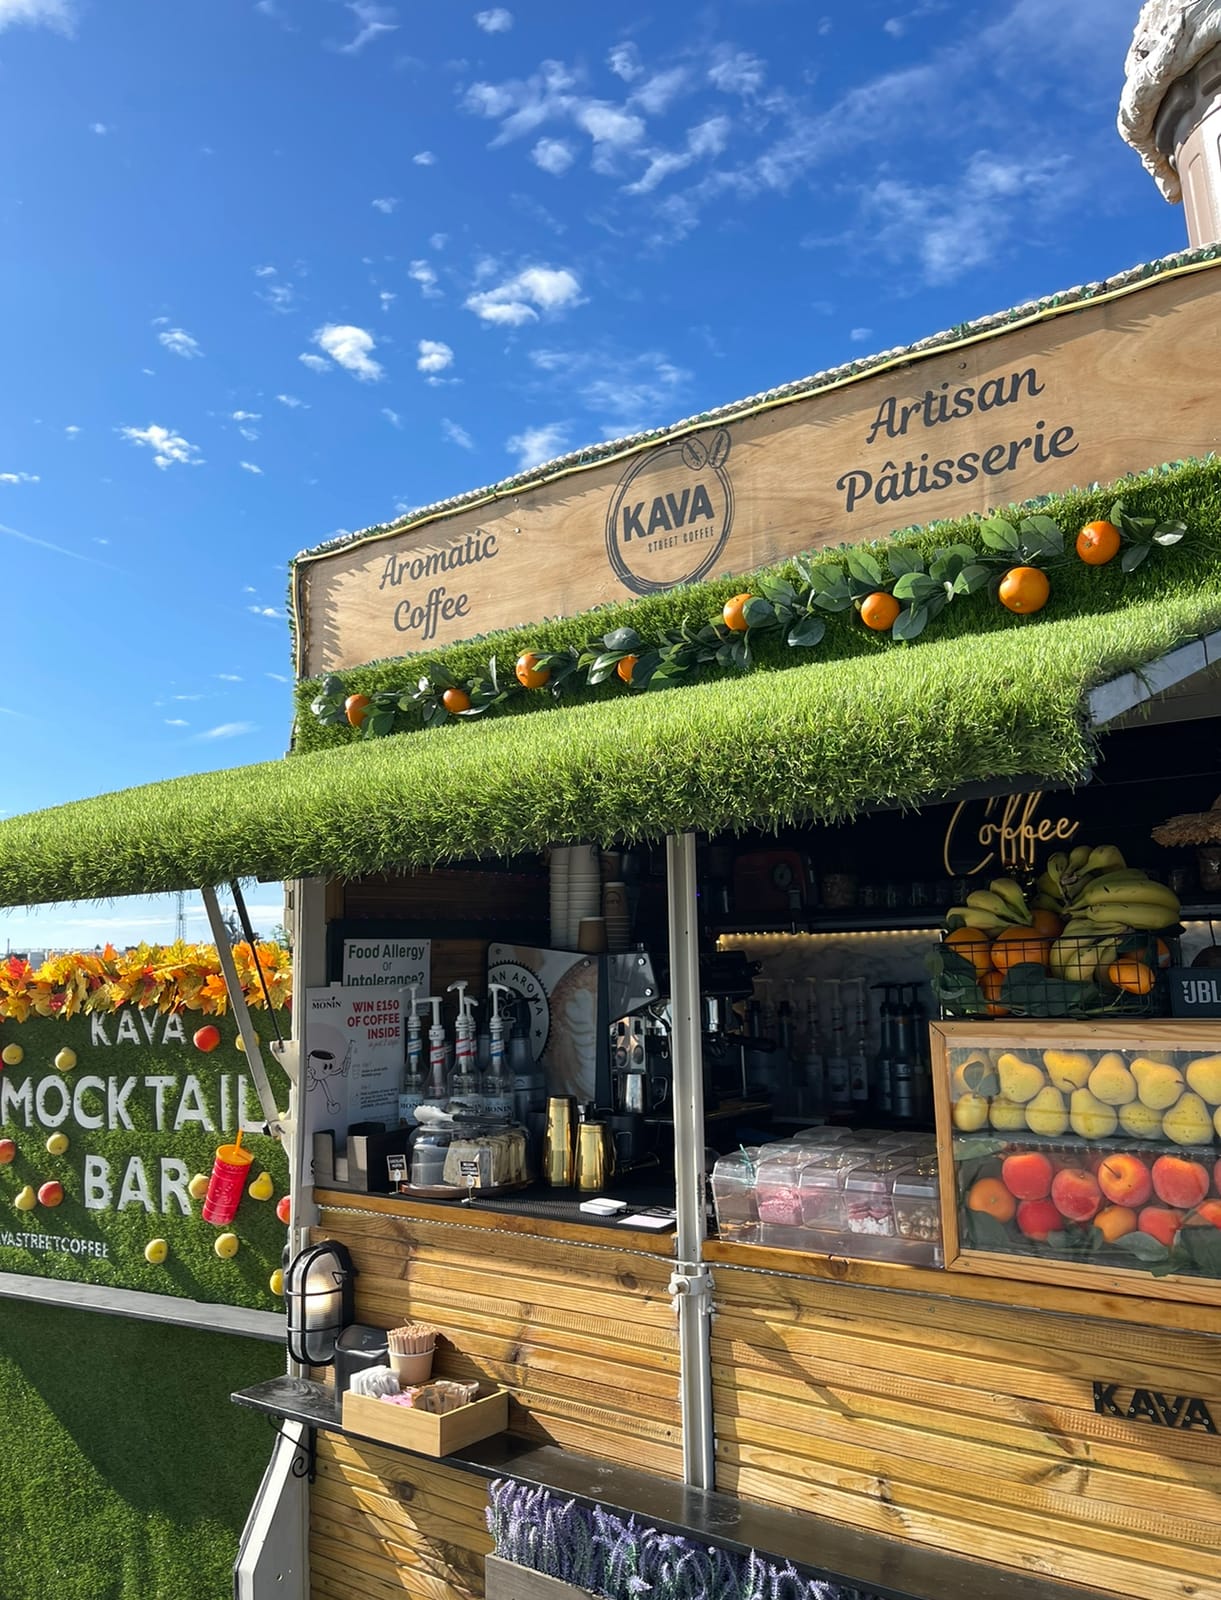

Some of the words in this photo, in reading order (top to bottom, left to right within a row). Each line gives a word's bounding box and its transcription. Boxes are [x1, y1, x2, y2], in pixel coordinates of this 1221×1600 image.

[865, 367, 1045, 444] Artisan
[836, 421, 1080, 513] Pâtisserie
[623, 484, 715, 542] KAVA
[378, 529, 499, 590] Aromatic
[648, 535, 679, 553] STREET
[683, 526, 714, 544] COFFEE
[394, 587, 471, 640] Coffee
[943, 791, 1079, 876] Coffee
[349, 944, 380, 959] Food
[382, 943, 425, 961] Allergy
[312, 996, 342, 1010] MONIN
[352, 1001, 374, 1013] WIN
[376, 999, 400, 1011] £150
[511, 971, 544, 1016] AROMA
[1182, 980, 1221, 1004] JBL
[90, 1009, 188, 1047] KAVA
[347, 1016, 361, 1028] OF
[362, 1013, 400, 1026] COFFEE
[367, 1026, 401, 1040] INSIDE
[0, 1074, 265, 1133] MOCKTAIL
[84, 1154, 193, 1217] BAR
[0, 1231, 110, 1258] VASTREETCOFFEE
[1092, 1381, 1218, 1434] KAVA
